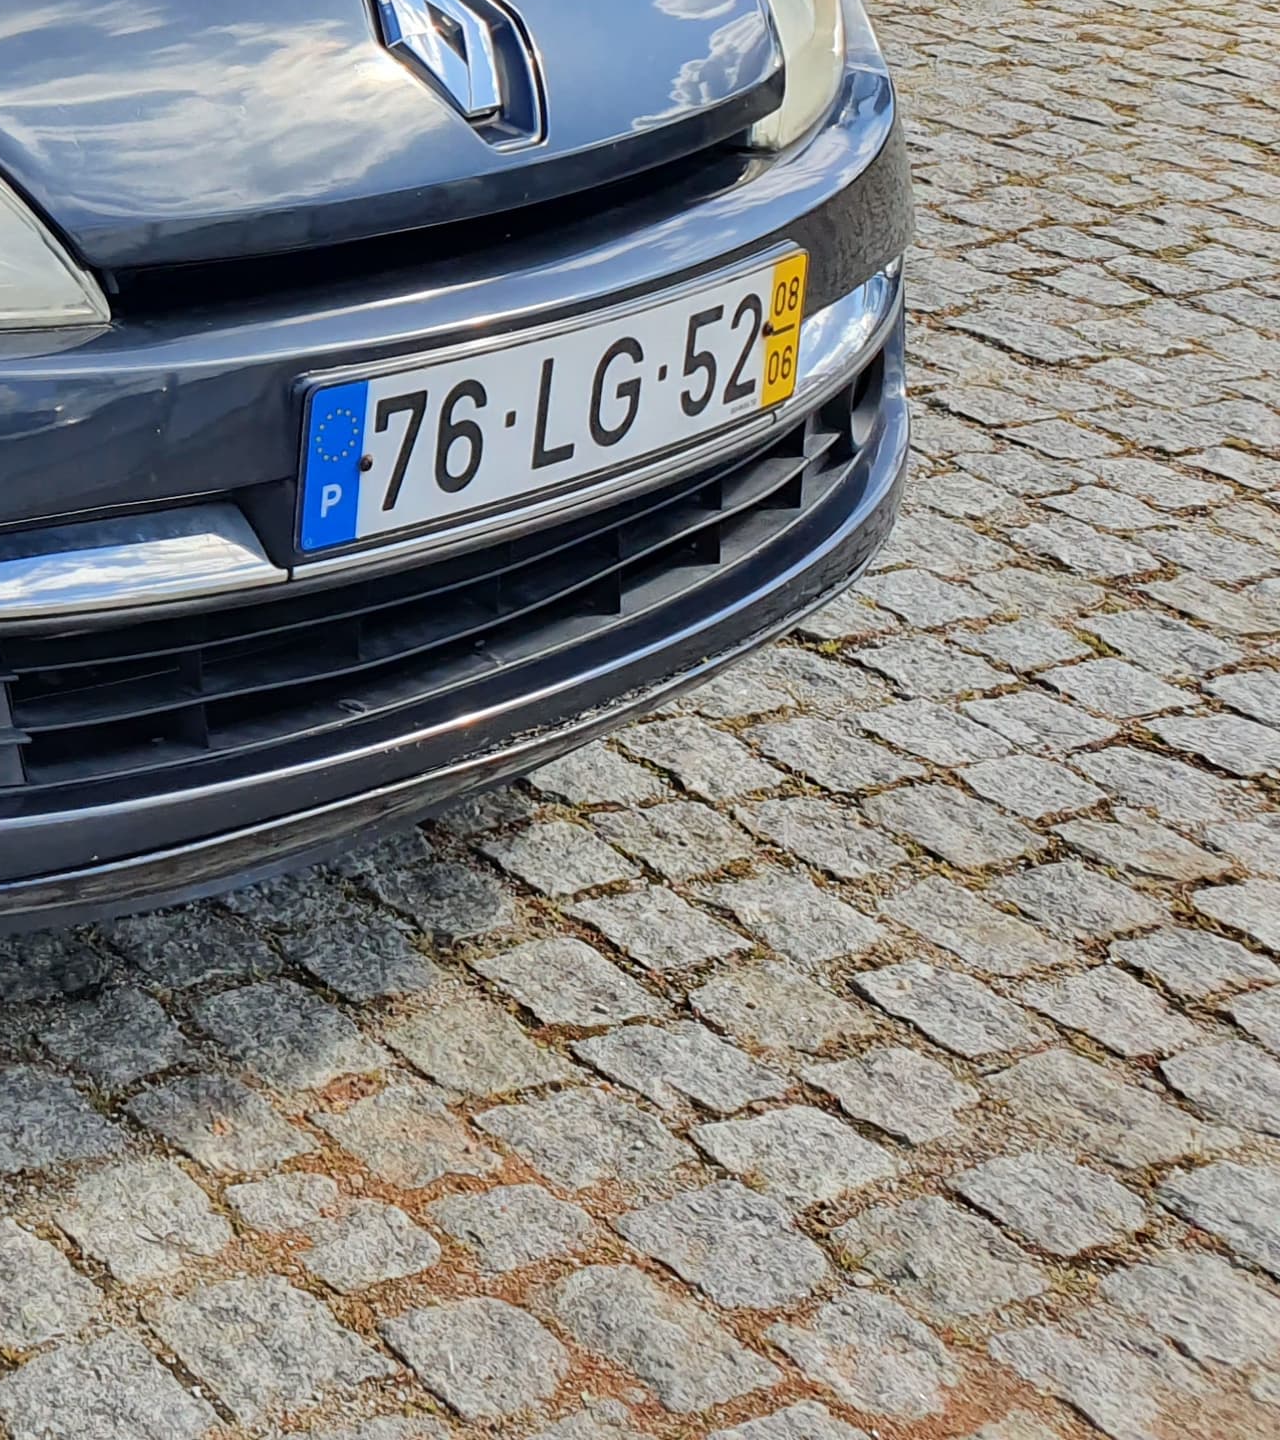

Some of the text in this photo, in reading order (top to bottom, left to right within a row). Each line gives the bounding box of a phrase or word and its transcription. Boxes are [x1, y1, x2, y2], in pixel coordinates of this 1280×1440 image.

[774, 276, 800, 317] 08
[767, 345, 793, 385] 06
[320, 483, 342, 518] P
